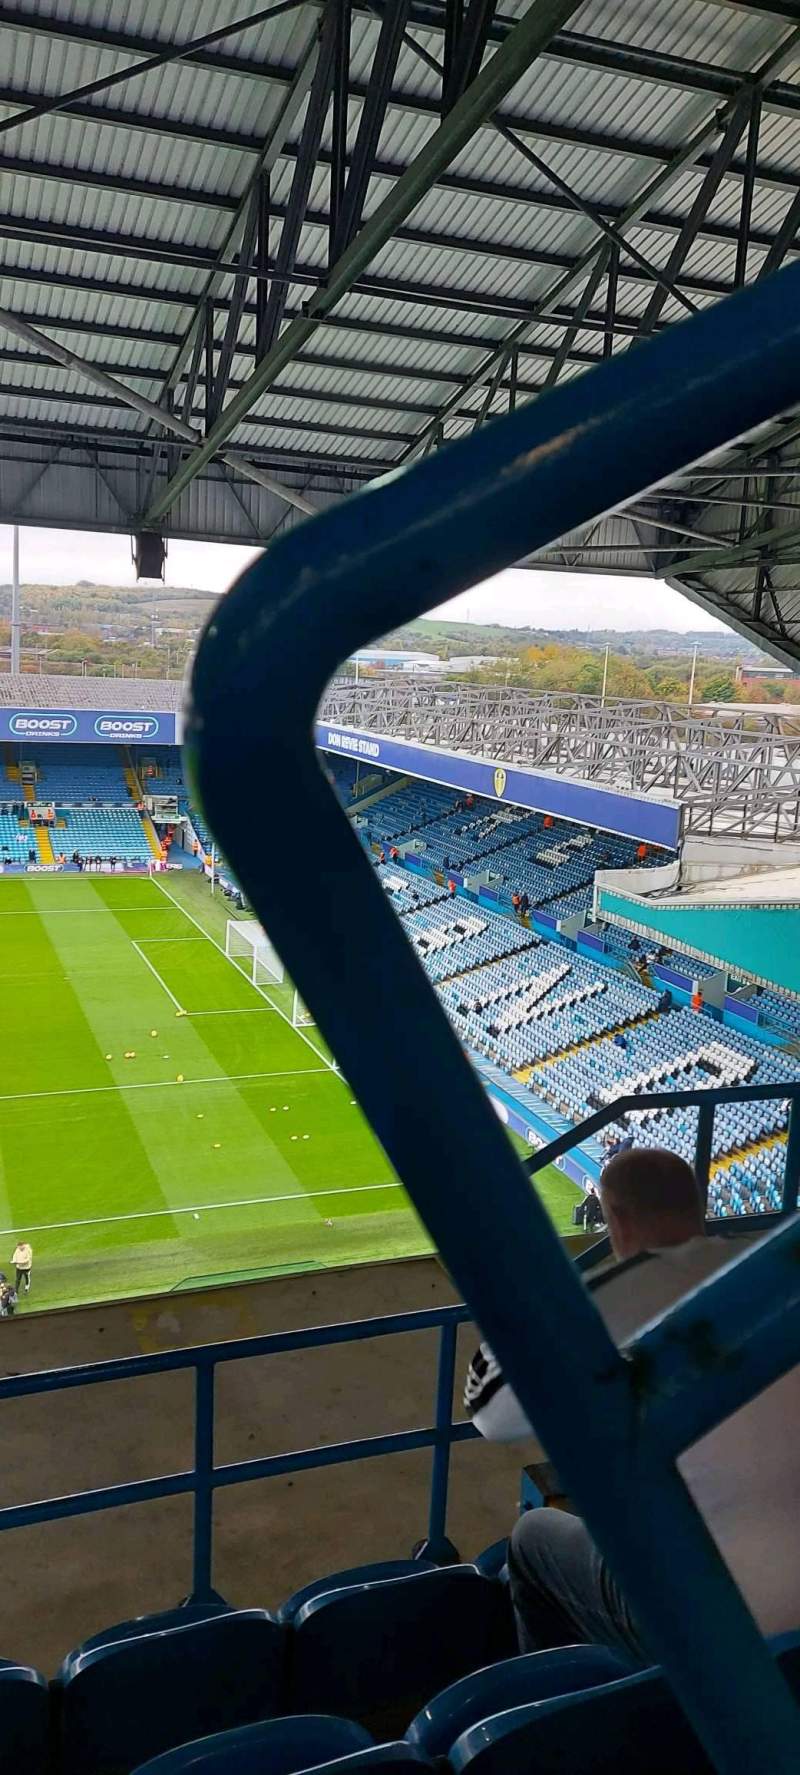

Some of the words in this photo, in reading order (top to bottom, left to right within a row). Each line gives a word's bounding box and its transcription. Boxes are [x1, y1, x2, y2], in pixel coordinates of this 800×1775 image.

[15, 718, 73, 729] BOOST
[100, 721, 154, 732] BOOST
[328, 732, 341, 747] DON
[359, 740, 380, 757] STAND
[26, 864, 61, 872] BOOST
